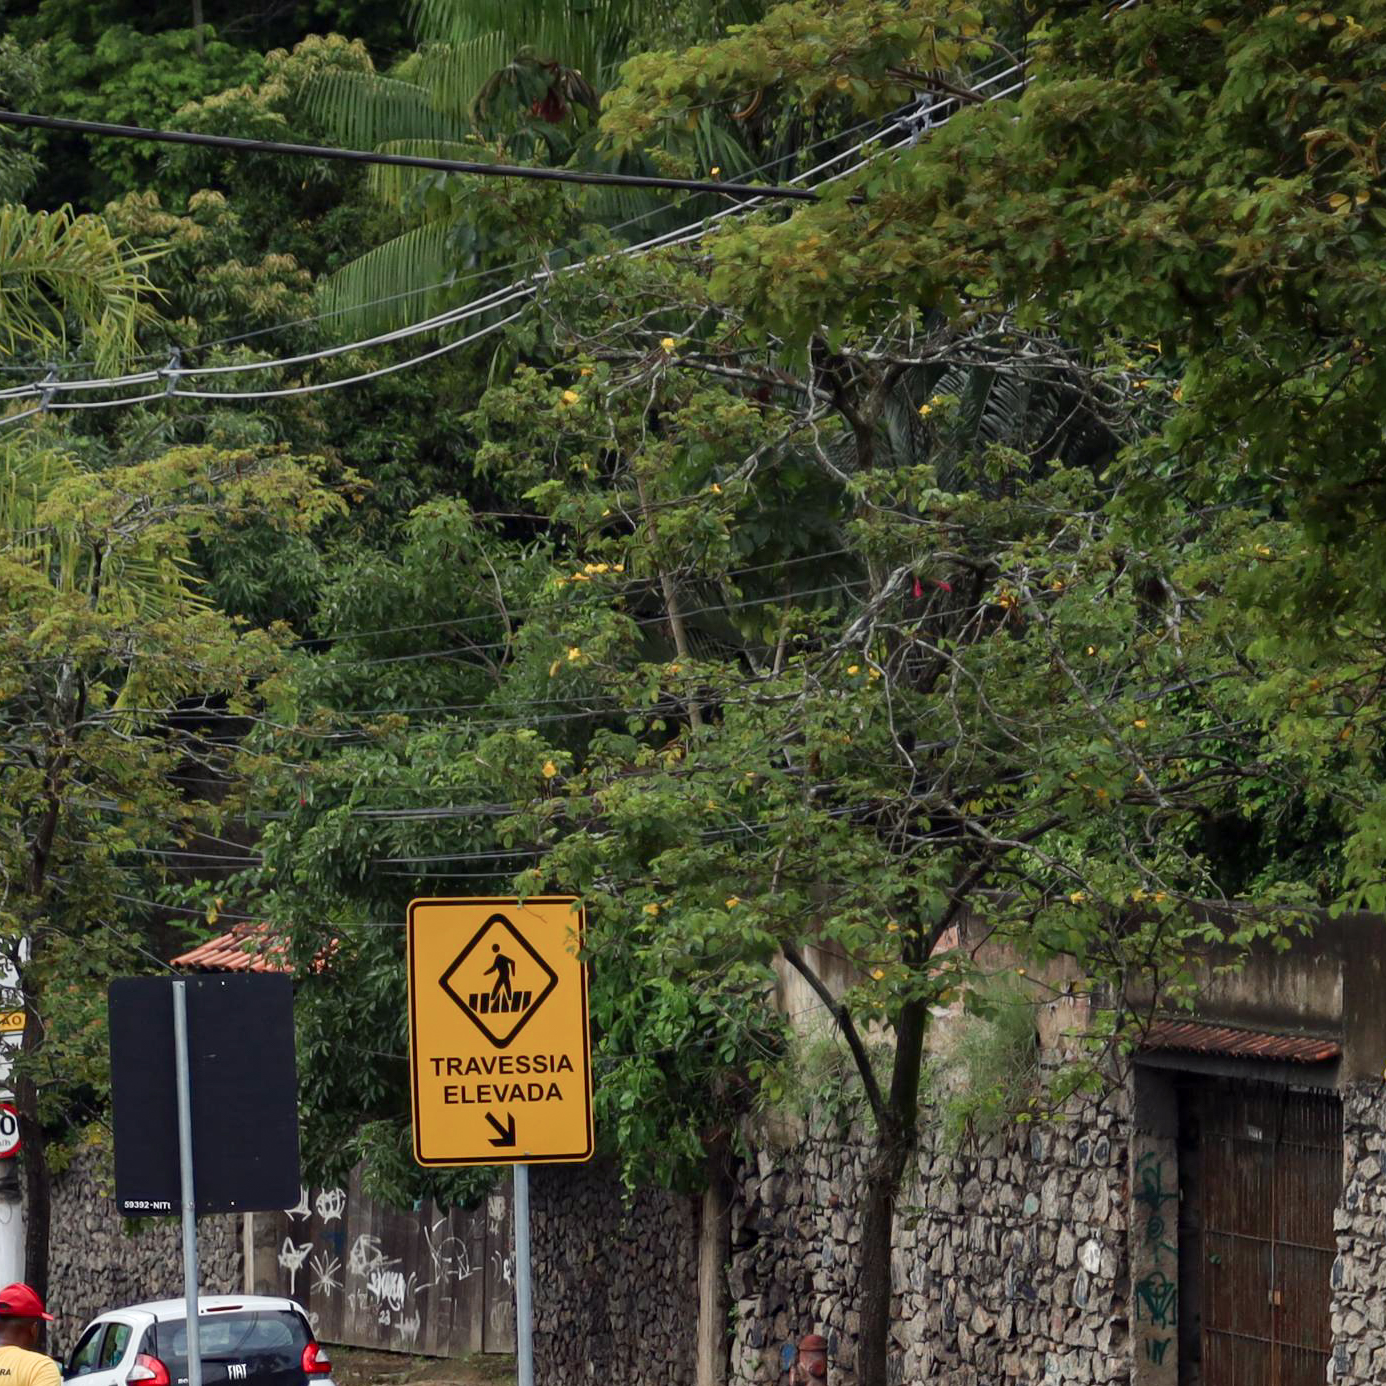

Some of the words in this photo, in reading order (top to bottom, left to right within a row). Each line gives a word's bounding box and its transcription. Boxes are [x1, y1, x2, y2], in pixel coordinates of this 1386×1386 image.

[430, 1054, 574, 1076] TRAVESSIA
[444, 1083, 563, 1104] ELEVADA
[227, 1363, 247, 1380] FIAT
